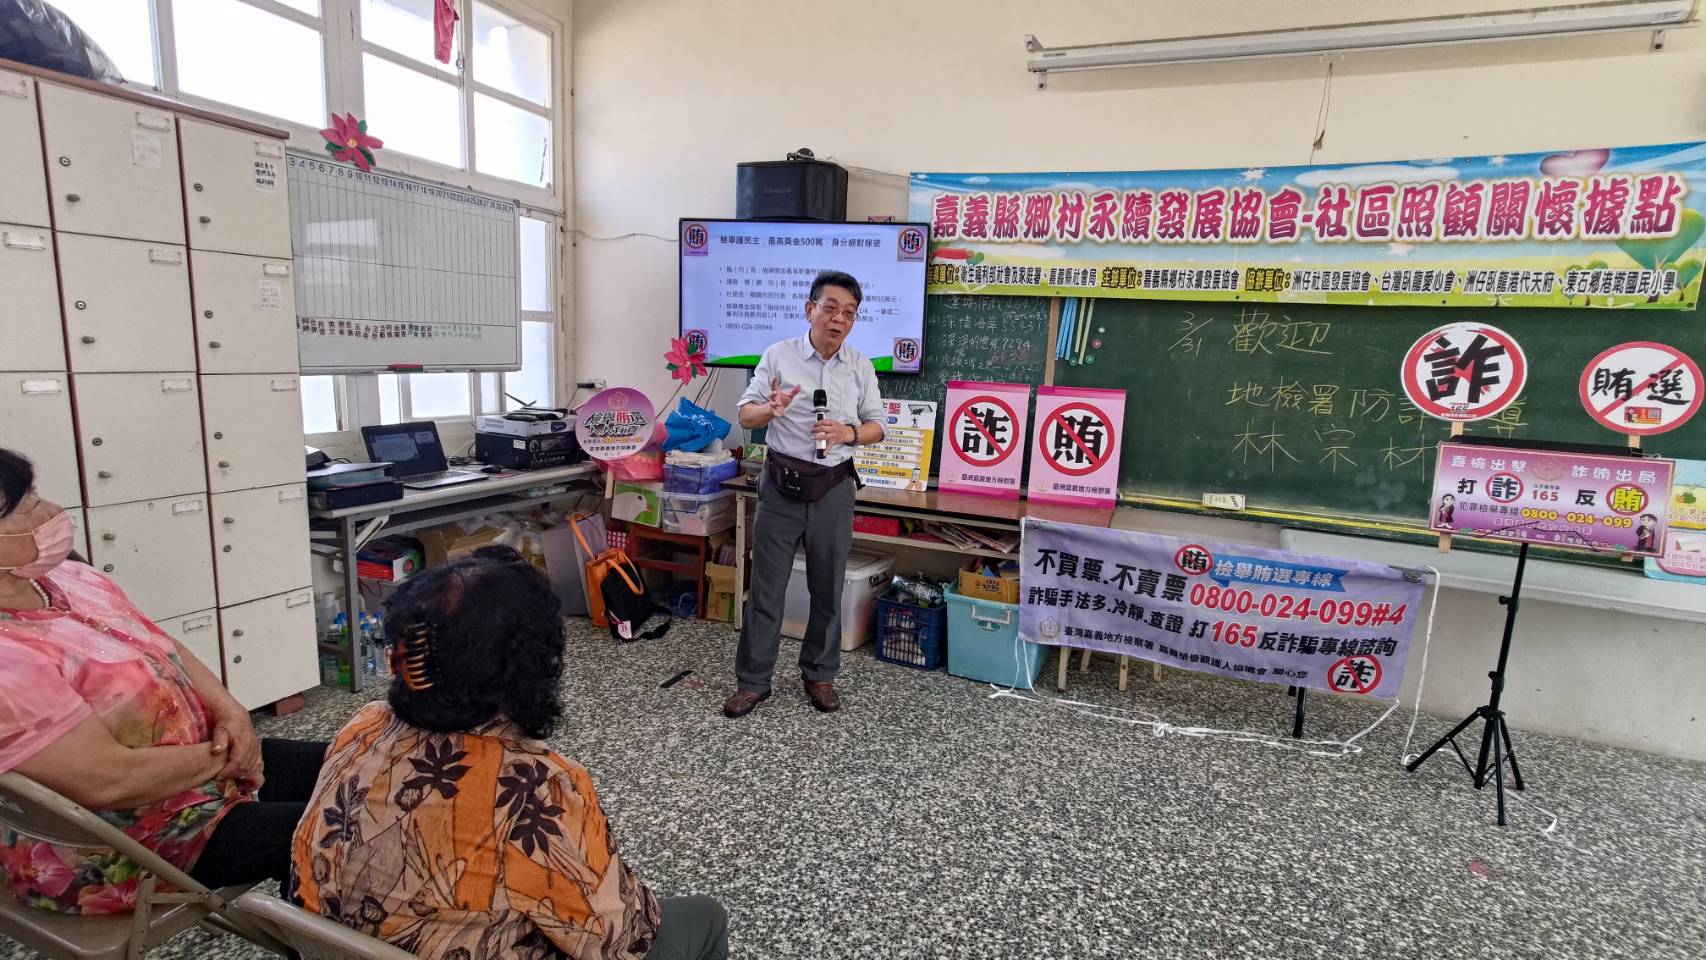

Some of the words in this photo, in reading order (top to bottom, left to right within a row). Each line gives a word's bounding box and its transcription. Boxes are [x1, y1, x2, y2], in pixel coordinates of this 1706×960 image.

[289, 157, 295, 166] 3
[299, 160, 305, 168] 4
[309, 162, 315, 170] 5
[318, 164, 325, 172] 6
[328, 166, 335, 174] 7
[337, 168, 344, 176] 8
[347, 170, 353, 178] 9
[355, 172, 363, 180] 10
[364, 174, 371, 182] 11
[373, 176, 380, 184] 12
[381, 178, 388, 186] 13
[390, 179, 396, 188] 14
[398, 181, 404, 189] 15
[406, 182, 412, 191] 16
[413, 183, 420, 192] 17
[421, 186, 427, 194] 18
[428, 187, 435, 196] 19
[435, 189, 442, 198] 20
[443, 190, 449, 199] 21
[449, 192, 456, 200] 22
[934, 176, 1681, 239] 嘉義縣鄉村永續發展協會-社區照顧關懷據點
[904, 232, 920, 250] 賄
[1228, 308, 1334, 354] 歡迎
[1424, 333, 1506, 404] 詐
[1591, 367, 1691, 406] 賄選
[963, 406, 1010, 455] 詐
[1053, 415, 1105, 464] 賄
[1457, 478, 1477, 494] 打
[1491, 477, 1518, 499] 詐
[1532, 490, 1559, 501] 165
[1575, 489, 1597, 506] 反
[1612, 487, 1644, 512] 賄
[1182, 550, 1208, 571] 賄
[1214, 560, 1335, 586] 檢舉賄選專線
[1190, 583, 1408, 627] 0800-024-099#4
[1335, 659, 1375, 688] 詐
